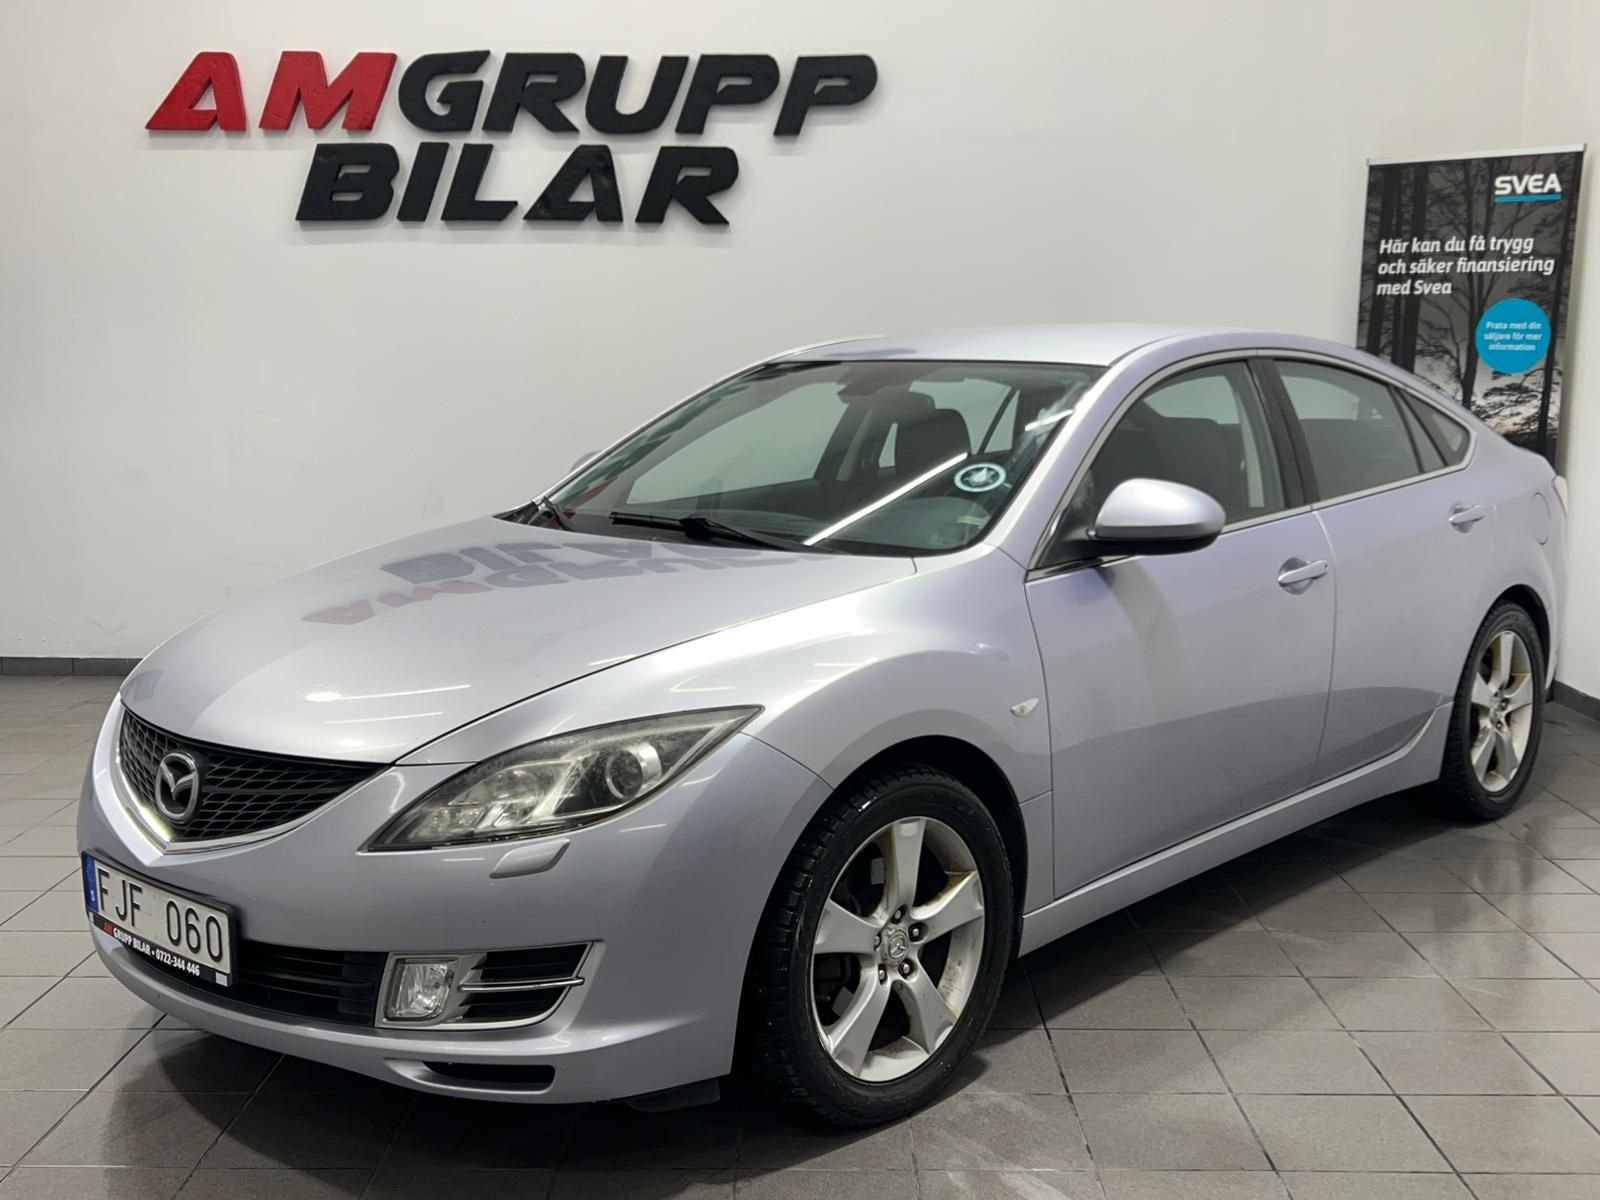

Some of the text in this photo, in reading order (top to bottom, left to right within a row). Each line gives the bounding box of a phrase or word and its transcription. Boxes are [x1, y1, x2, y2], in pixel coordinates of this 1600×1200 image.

[145, 50, 878, 135] AMGRUPP
[295, 142, 740, 225] BILAR
[1494, 173, 1562, 196] SVEA
[1379, 235, 1535, 254] Här kan du få trygg
[1377, 256, 1555, 276] och säker finansiering
[1376, 279, 1452, 296] med Svea
[1528, 321, 1542, 329] din
[1487, 342, 1536, 351] information
[97, 868, 223, 962] FJF 060
[156, 949, 185, 971] 0722-344
[186, 962, 200, 977] 446
